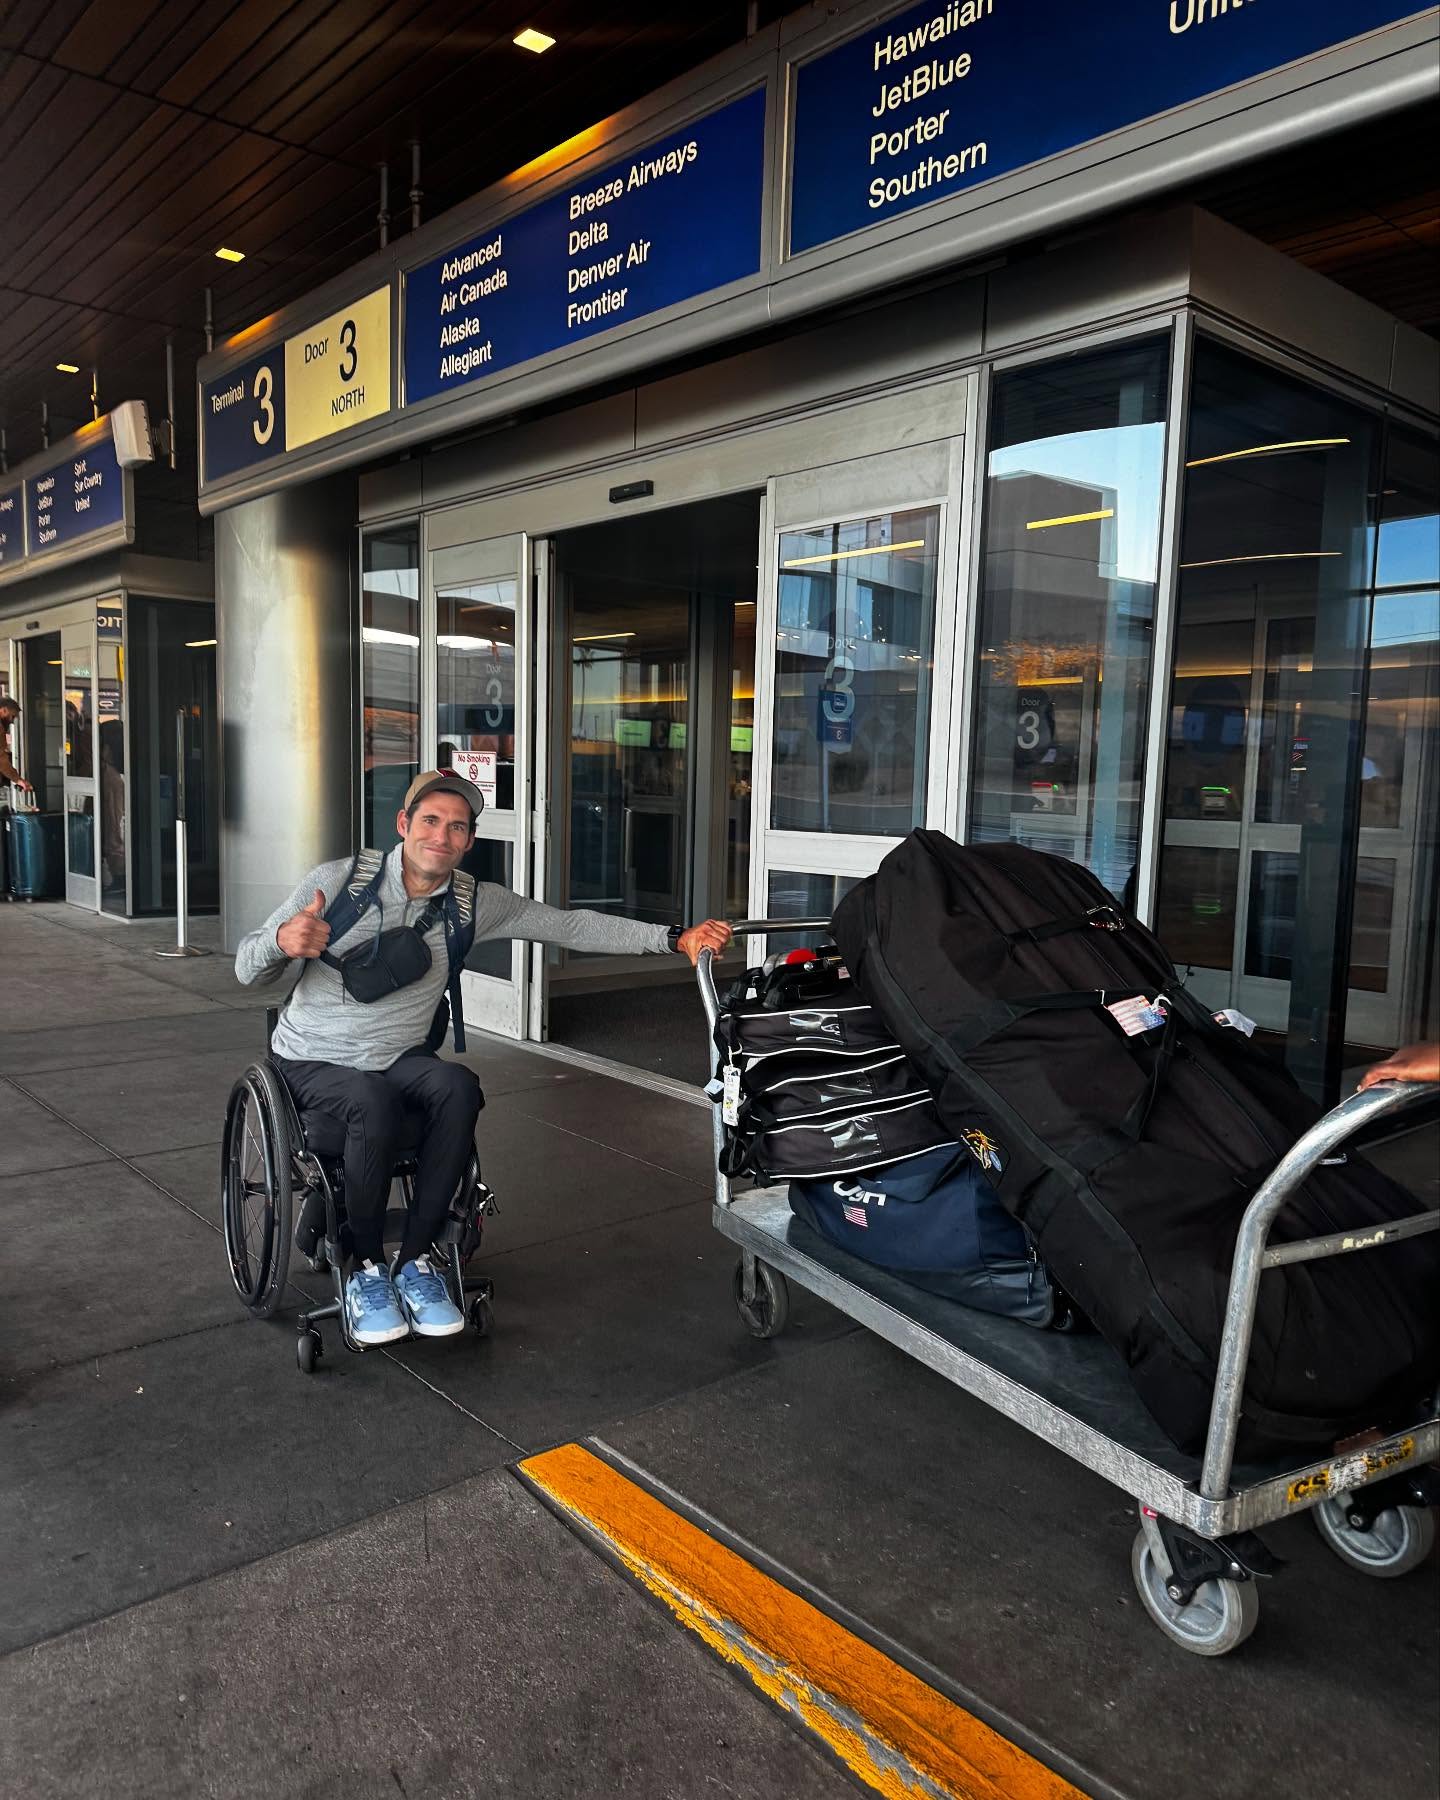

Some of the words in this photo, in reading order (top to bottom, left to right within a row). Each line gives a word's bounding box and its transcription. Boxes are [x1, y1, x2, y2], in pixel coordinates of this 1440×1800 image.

[874, 0, 993, 71] Hawaiian
[872, 52, 972, 117] JetBlue
[870, 109, 950, 165] Porter
[569, 177, 623, 221] Breeze
[626, 140, 698, 193] Airways
[868, 142, 987, 208] Southern
[440, 235, 502, 284] Advanced
[568, 221, 609, 256] Delta
[567, 255, 621, 294] Denver
[626, 240, 650, 269] Air
[440, 292, 456, 316] Air
[459, 268, 508, 305] Canada
[567, 287, 628, 328] Frontier
[304, 338, 329, 364] Door
[339, 319, 358, 382] 3
[440, 316, 480, 349] Alaska
[440, 340, 493, 379] Allegiant
[211, 379, 245, 414] Terminal
[253, 366, 275, 445] 3
[331, 385, 365, 416] NORTH
[486, 663, 502, 674] Door
[824, 655, 856, 722] 3
[485, 677, 504, 728] 3
[1020, 697, 1040, 707] Door
[1017, 710, 1040, 750] 3
[457, 754, 465, 763] No
[466, 753, 491, 766] Smoking
